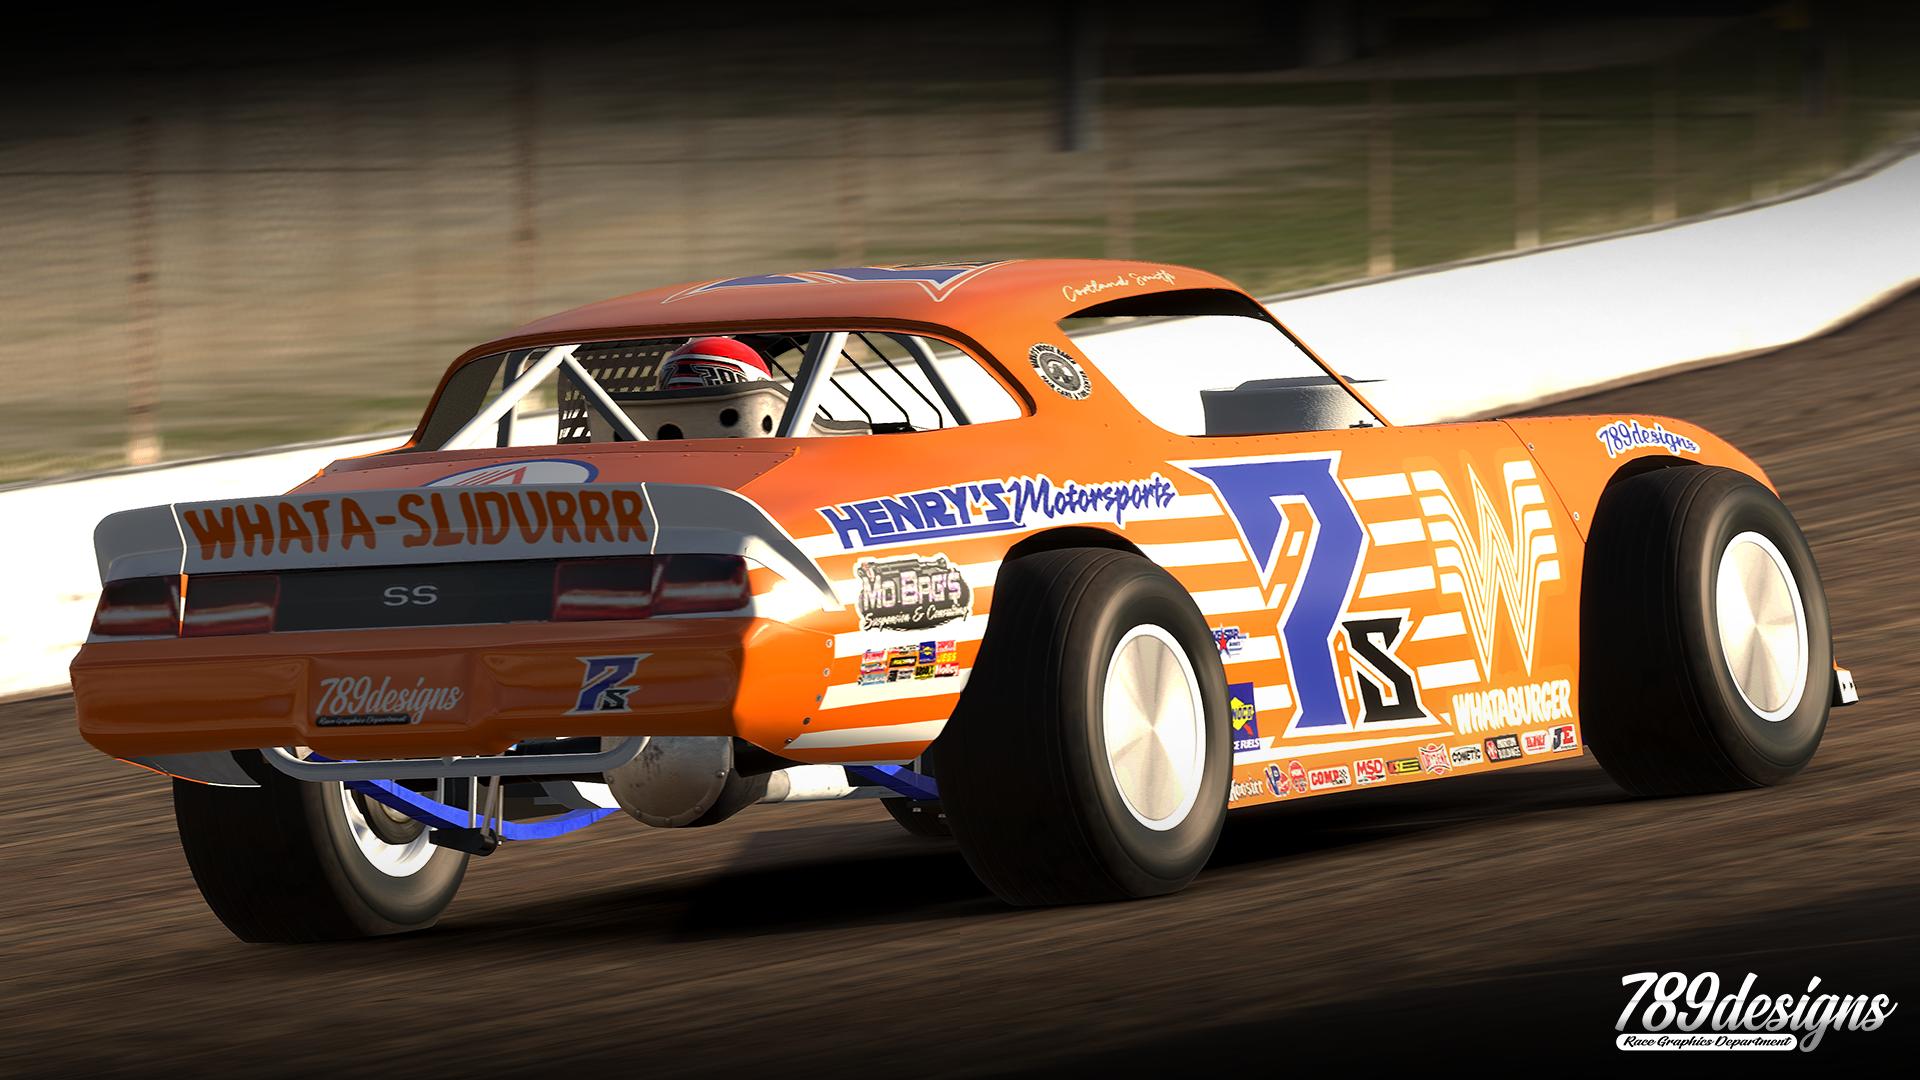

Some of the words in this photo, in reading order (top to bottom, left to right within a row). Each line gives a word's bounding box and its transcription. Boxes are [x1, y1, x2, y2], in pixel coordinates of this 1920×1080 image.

[1599, 421, 1697, 456] 789designs
[183, 489, 649, 561] WHATA-SLIDURRR
[821, 482, 1012, 549] HENRY'S
[1007, 475, 1176, 525] Motorsports
[383, 584, 439, 607] SS
[315, 675, 464, 726] 789designs
[1233, 705, 1255, 721] NOCO
[1452, 679, 1574, 736] WHATABURGER
[1311, 769, 1340, 788] COMP
[1356, 759, 1383, 777] MSD
